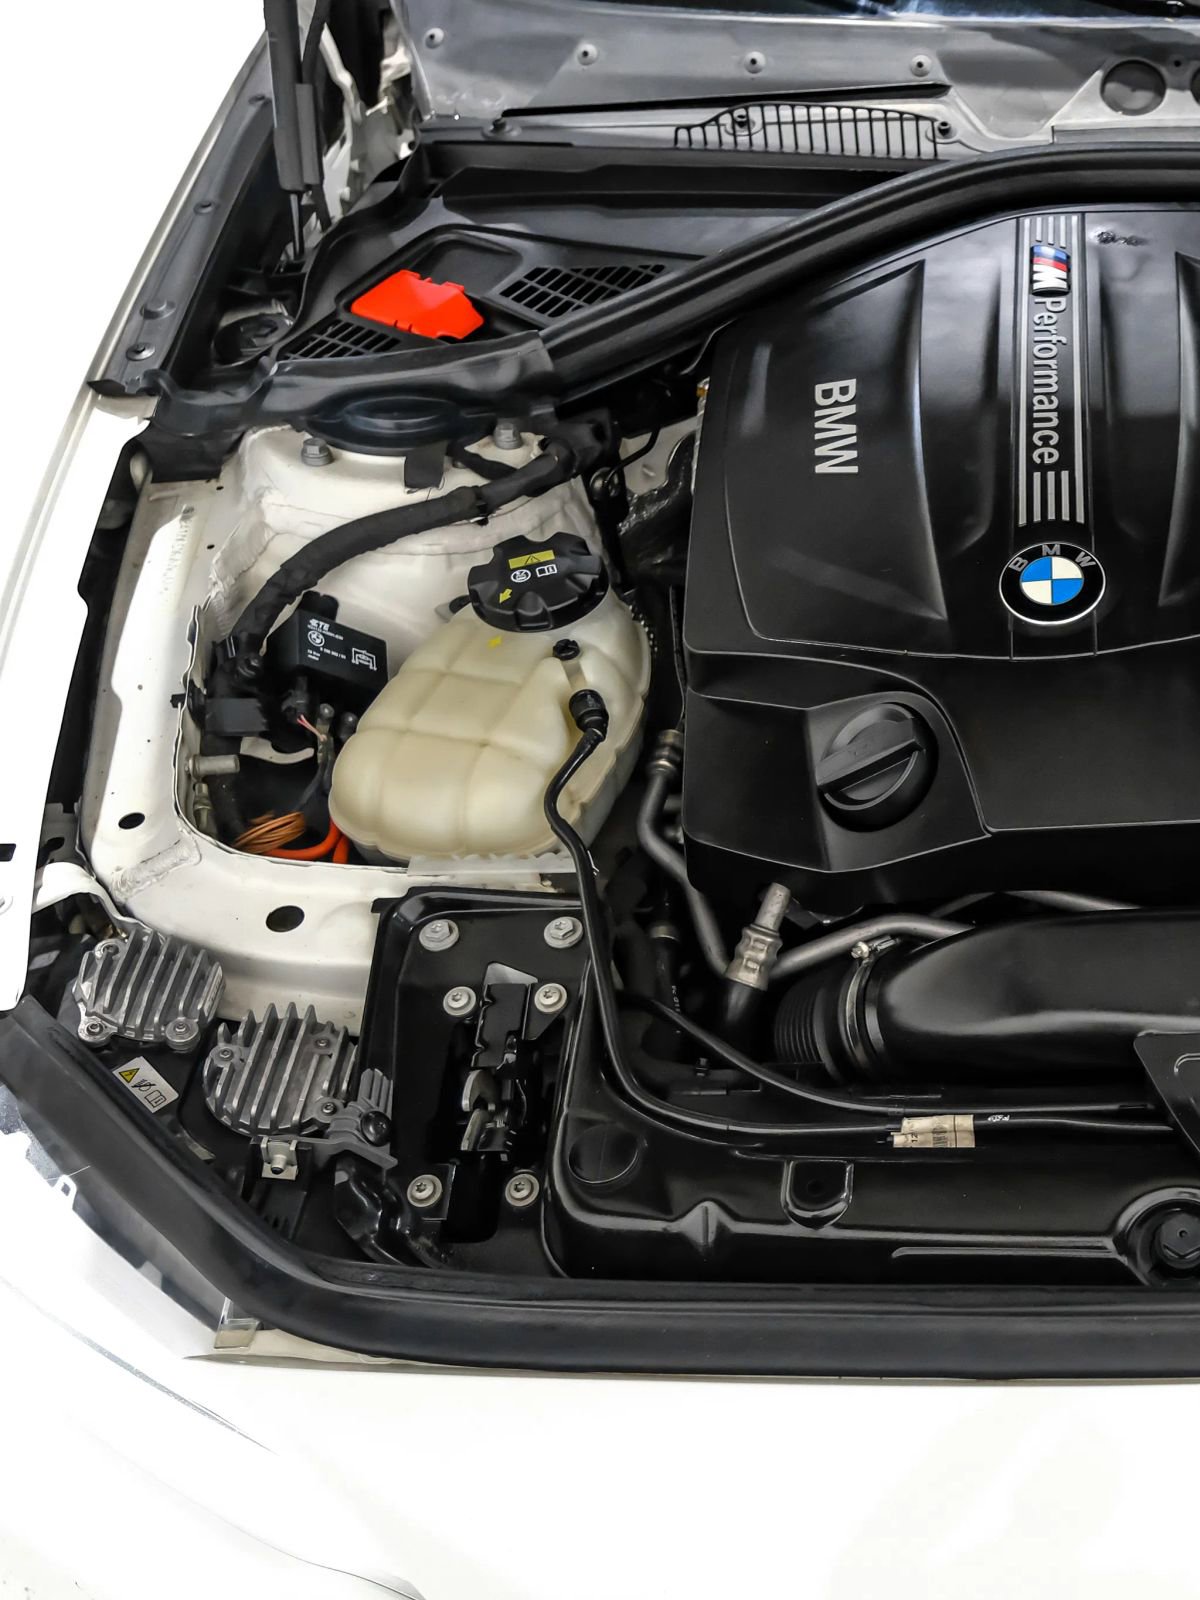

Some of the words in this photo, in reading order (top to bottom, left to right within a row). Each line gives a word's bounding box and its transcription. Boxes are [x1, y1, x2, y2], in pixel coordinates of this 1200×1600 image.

[814, 378, 859, 473] BMW
[1031, 297, 1067, 465] Performance
[1008, 543, 1097, 572] BMW
